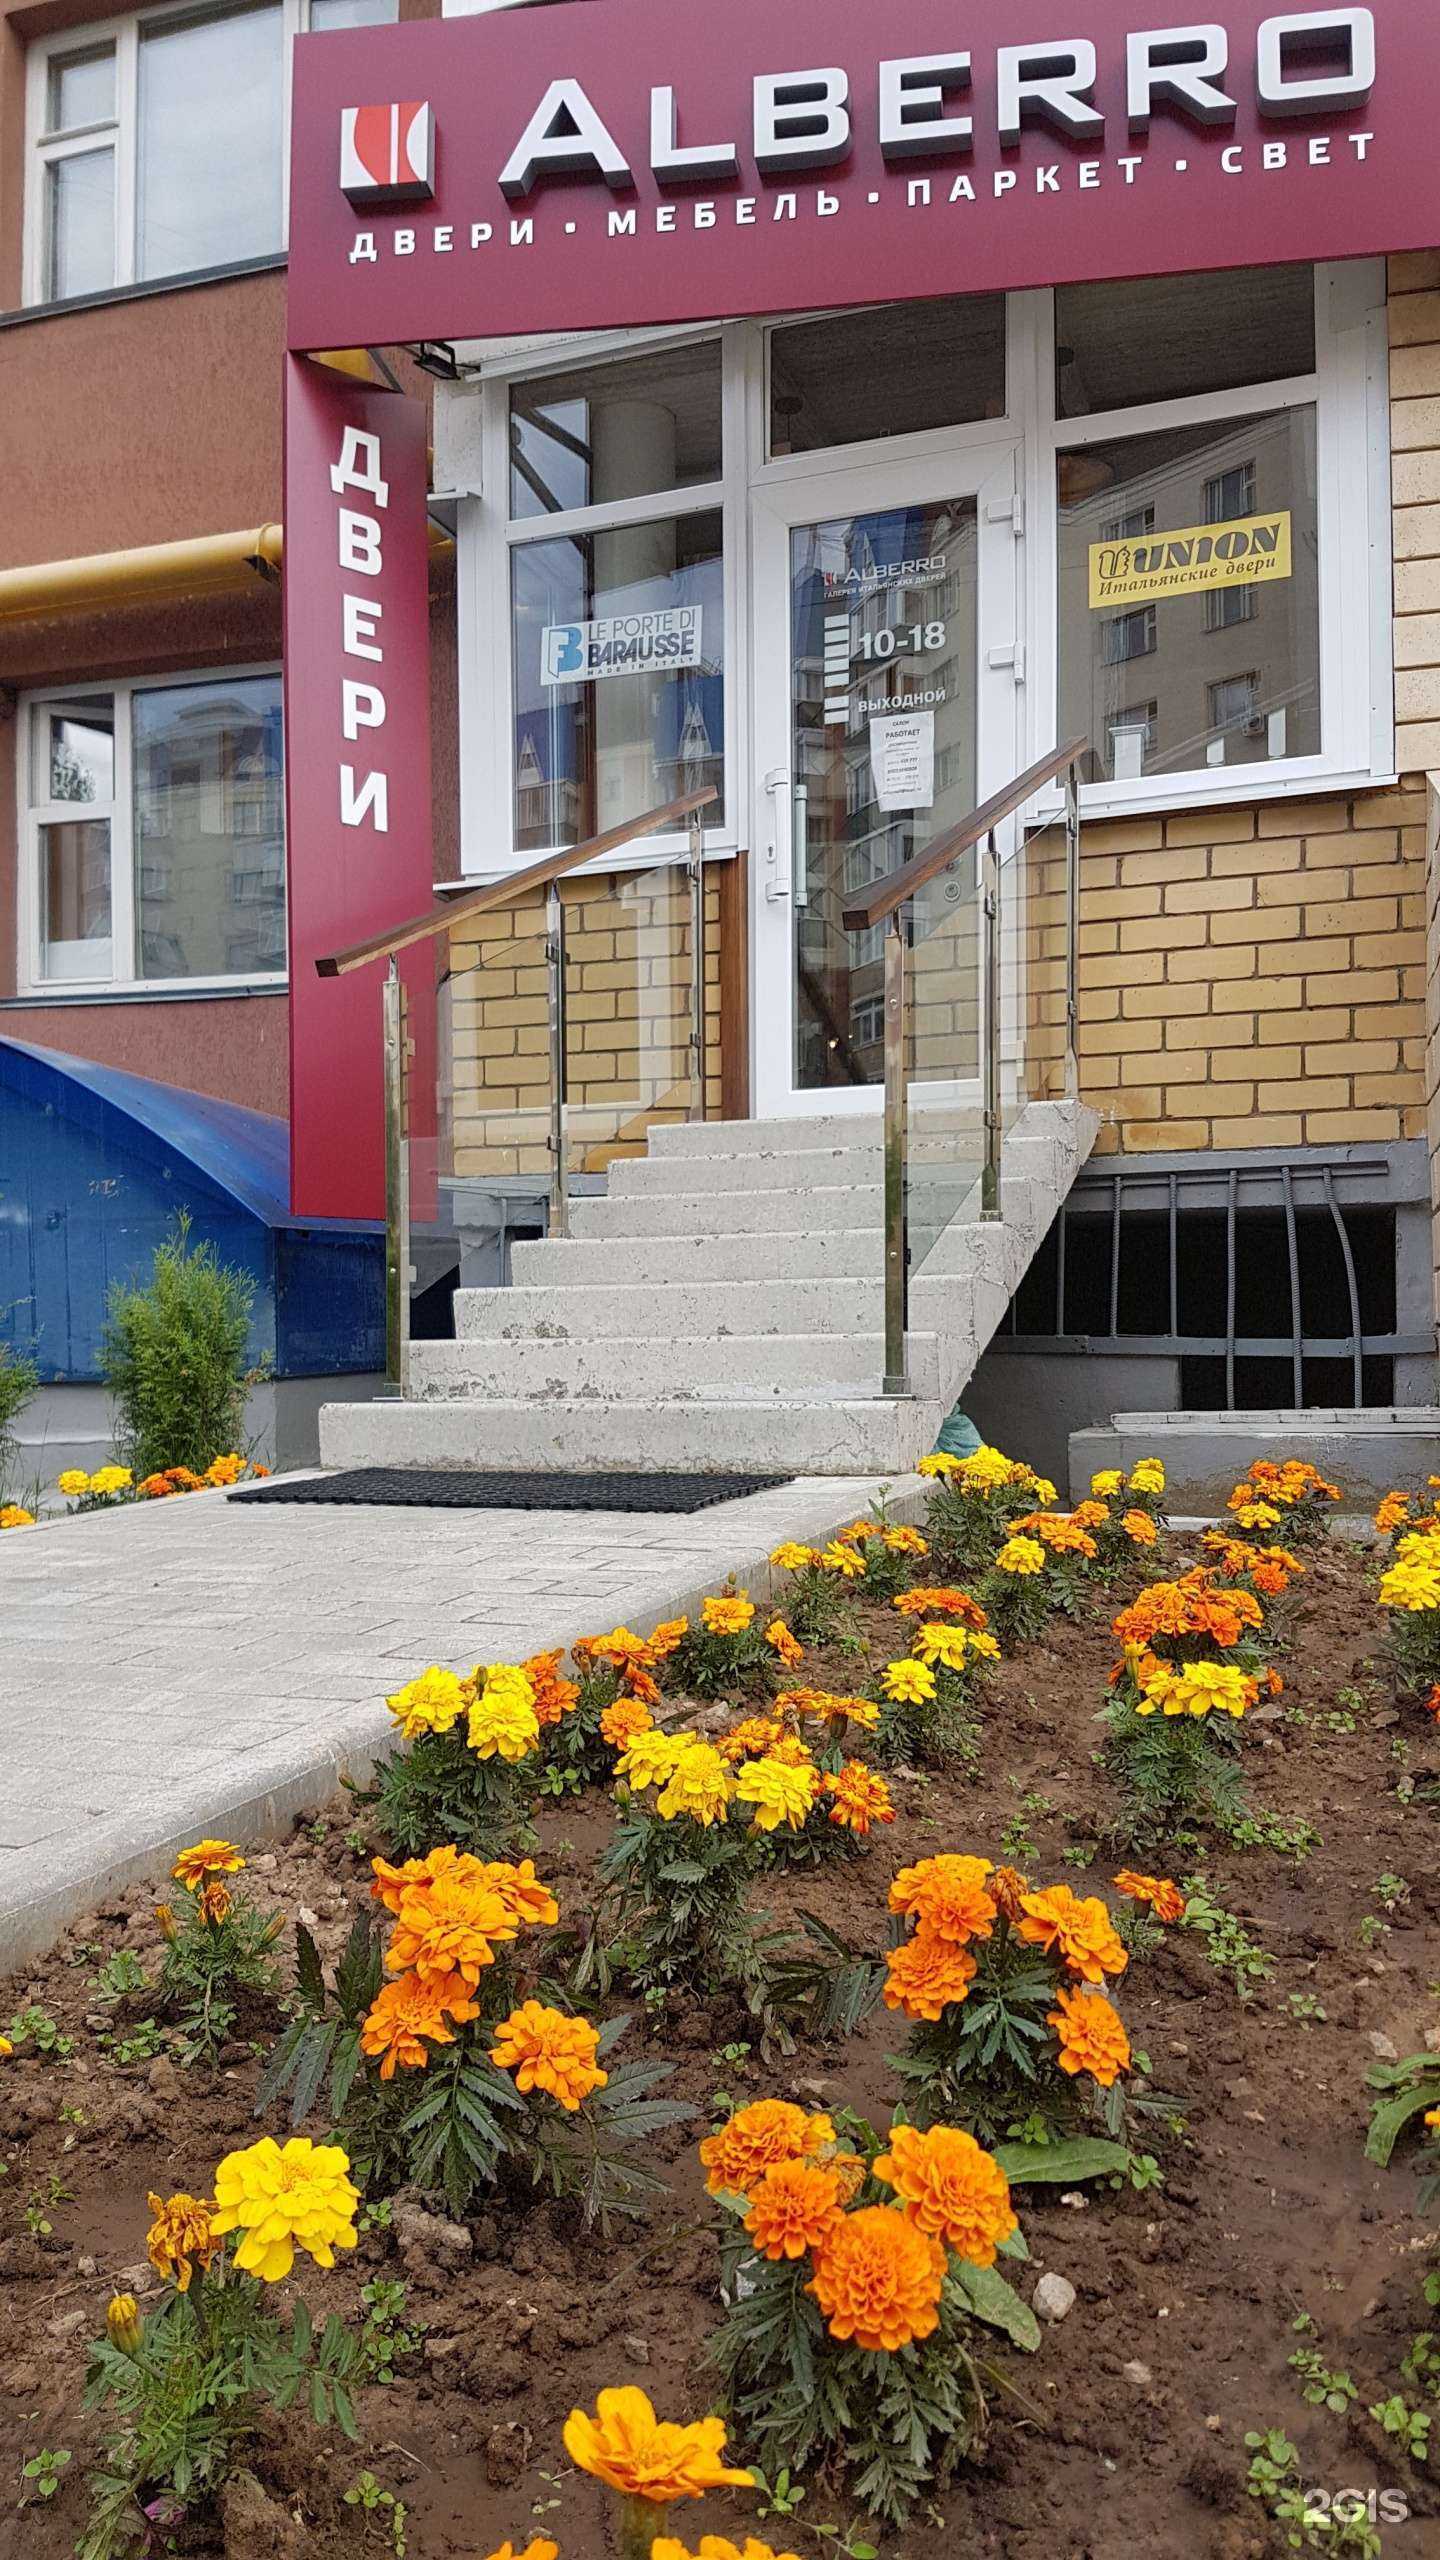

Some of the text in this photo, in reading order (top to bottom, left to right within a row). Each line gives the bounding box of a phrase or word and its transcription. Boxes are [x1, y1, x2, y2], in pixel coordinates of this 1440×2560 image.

[498, 7, 1376, 192] ALBERRO
[349, 132, 1375, 264] ДВЕРИ МЕБЕЛЬ ПАРКЕТ СВЕТ
[1132, 522, 1281, 574] UNION
[843, 555, 946, 584] ALBERRO
[1098, 556, 1276, 597] Итальянские двери
[329, 424, 390, 833] ДВЕРИ
[588, 608, 696, 642] LE PORTE DI
[858, 620, 946, 660] 10-18
[587, 666, 621, 676] MADE
[655, 656, 694, 667] ITALY
[588, 630, 695, 668] BARAUSSE
[858, 687, 946, 713] ВЫХОДНОЙ
[885, 728, 921, 739] РАБОТАЕТ
